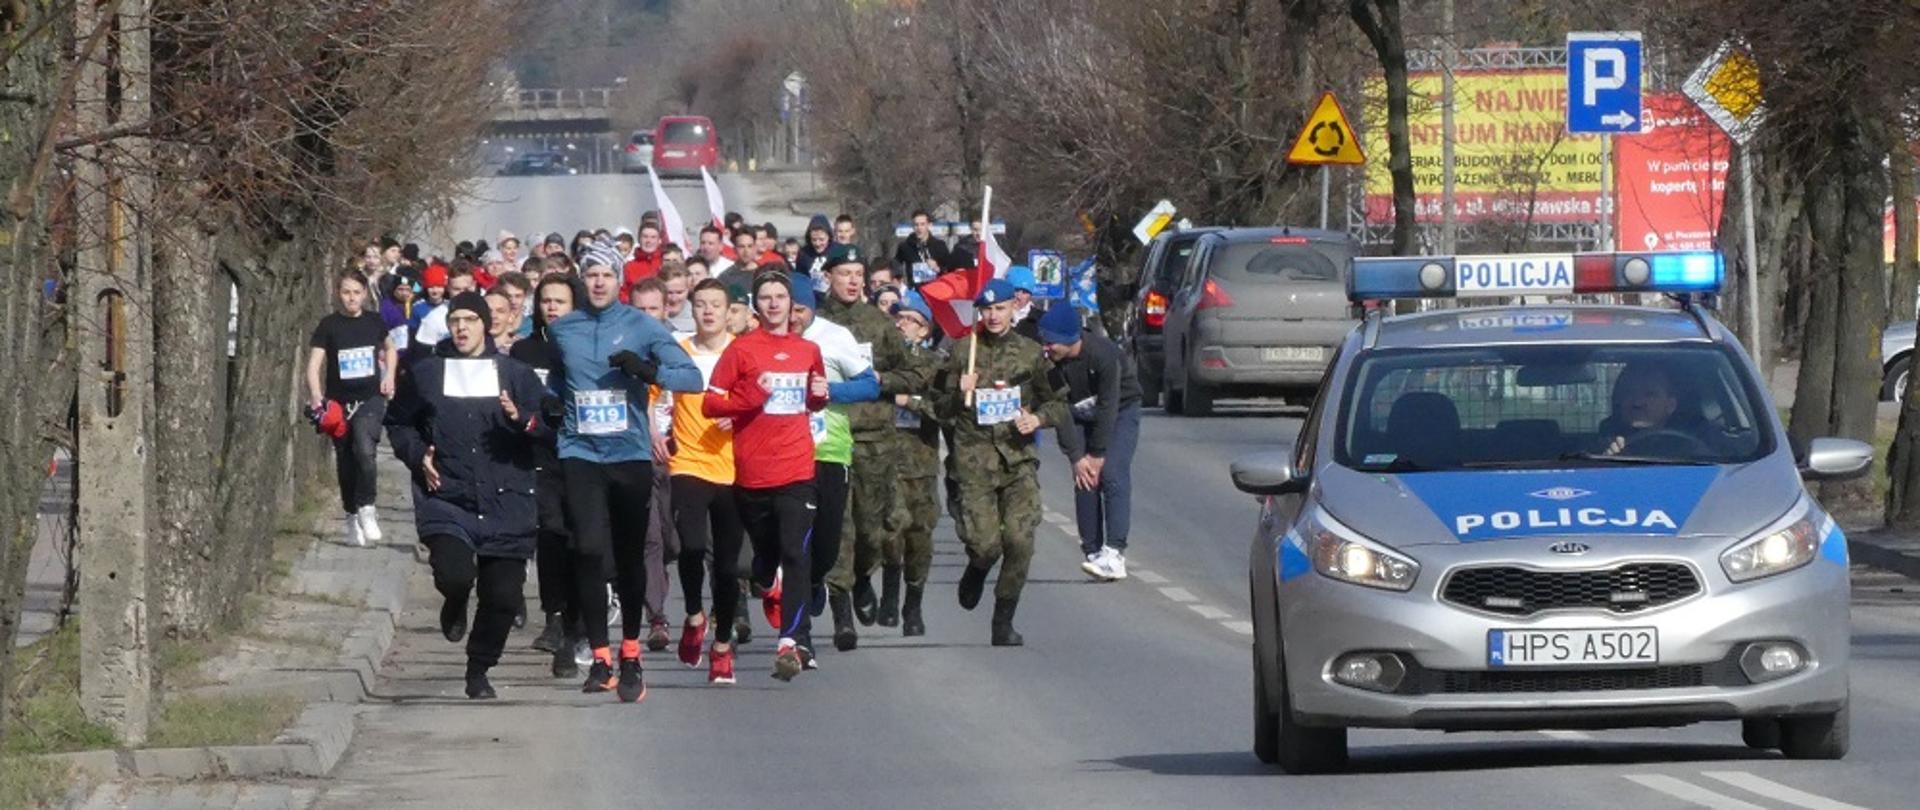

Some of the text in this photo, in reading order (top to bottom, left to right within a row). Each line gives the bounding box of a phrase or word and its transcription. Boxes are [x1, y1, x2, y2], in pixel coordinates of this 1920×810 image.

[1583, 48, 1627, 105] P
[1646, 160, 1661, 172] W
[1460, 261, 1570, 288] POLICJA
[585, 407, 619, 422] 219
[1456, 507, 1678, 534] POLICJA
[1509, 632, 1652, 661] HPS A502
